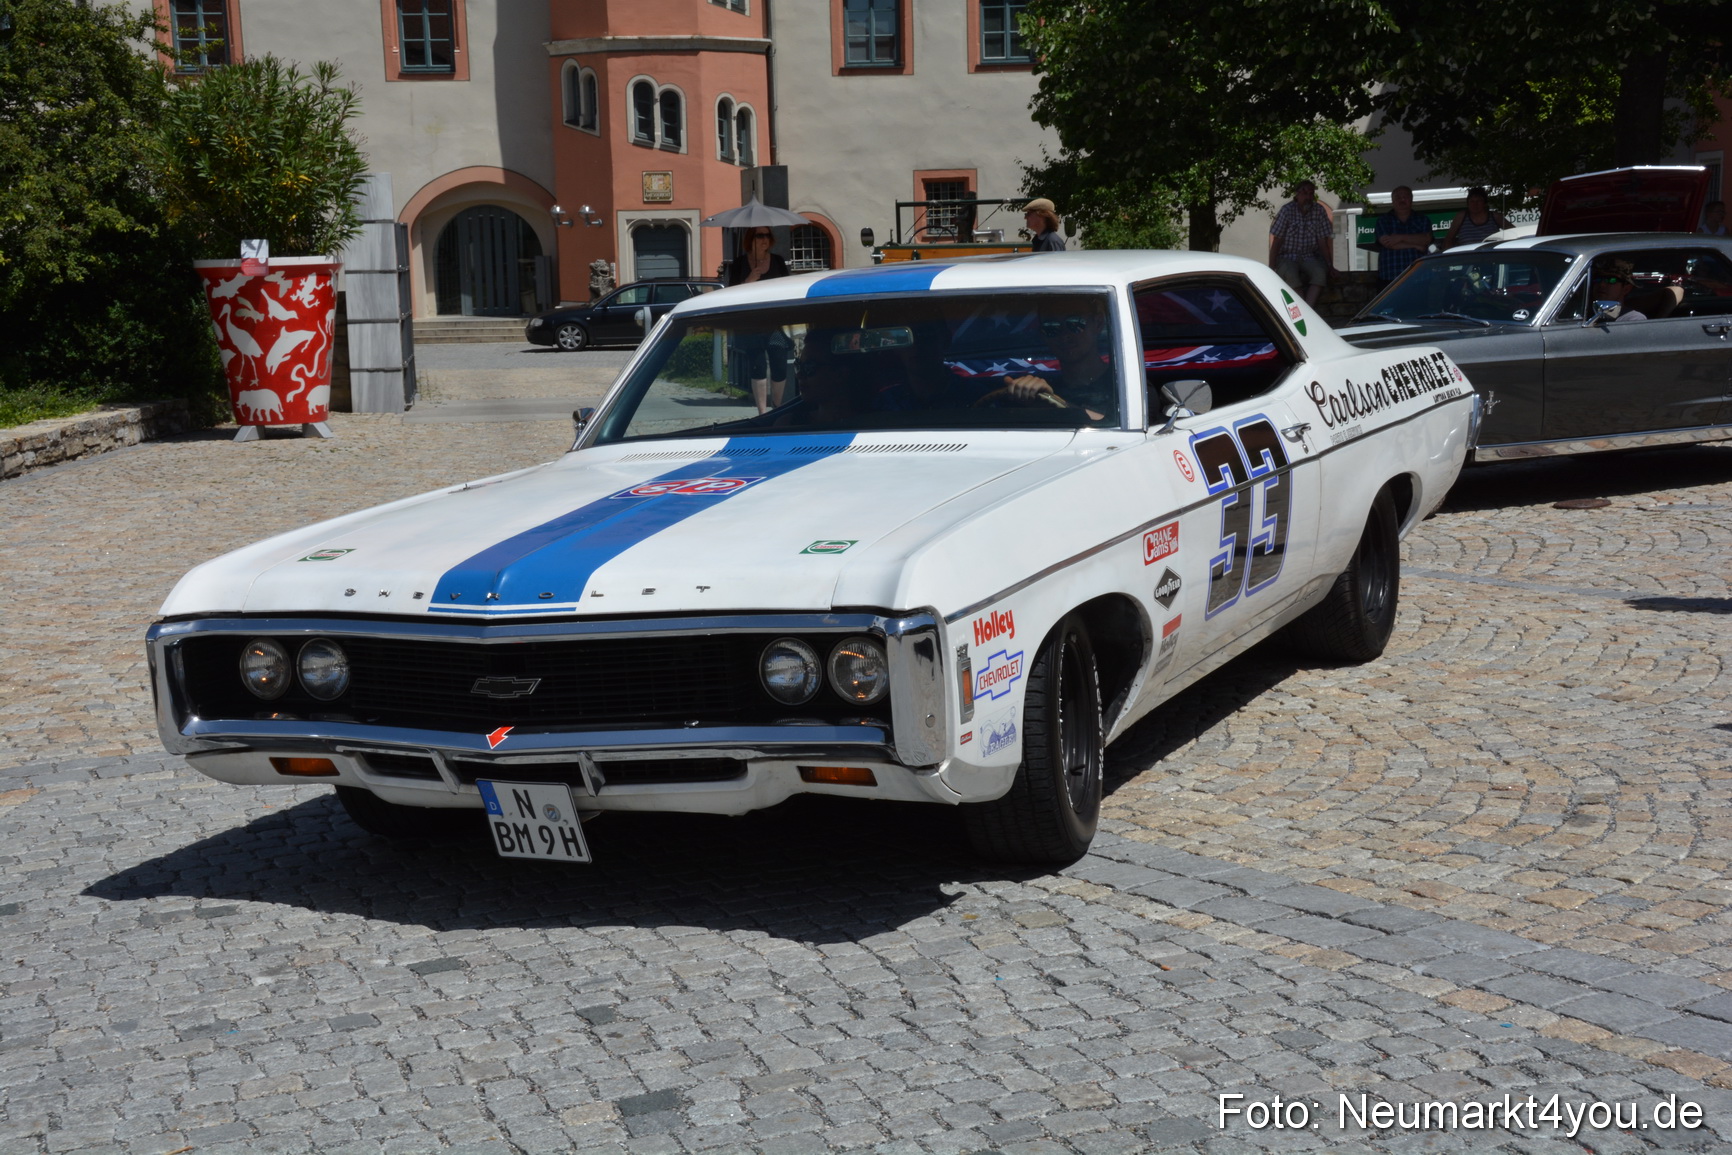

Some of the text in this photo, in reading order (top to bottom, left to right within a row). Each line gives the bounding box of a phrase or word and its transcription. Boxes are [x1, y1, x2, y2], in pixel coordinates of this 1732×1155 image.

[1508, 213, 1541, 224] DEKRA
[1304, 352, 1455, 430] Carlson CHEVROLET
[638, 478, 736, 494] STP
[1189, 413, 1293, 621] 33
[1144, 526, 1172, 561] CRANE
[344, 585, 711, 600] CHEVROLET
[1155, 578, 1181, 599] GOODYEAR
[973, 609, 1015, 647] Holley
[979, 659, 1019, 690] CHEVROLET
[489, 801, 498, 811] D
[512, 788, 537, 820] N
[494, 821, 583, 858] BM 9H
